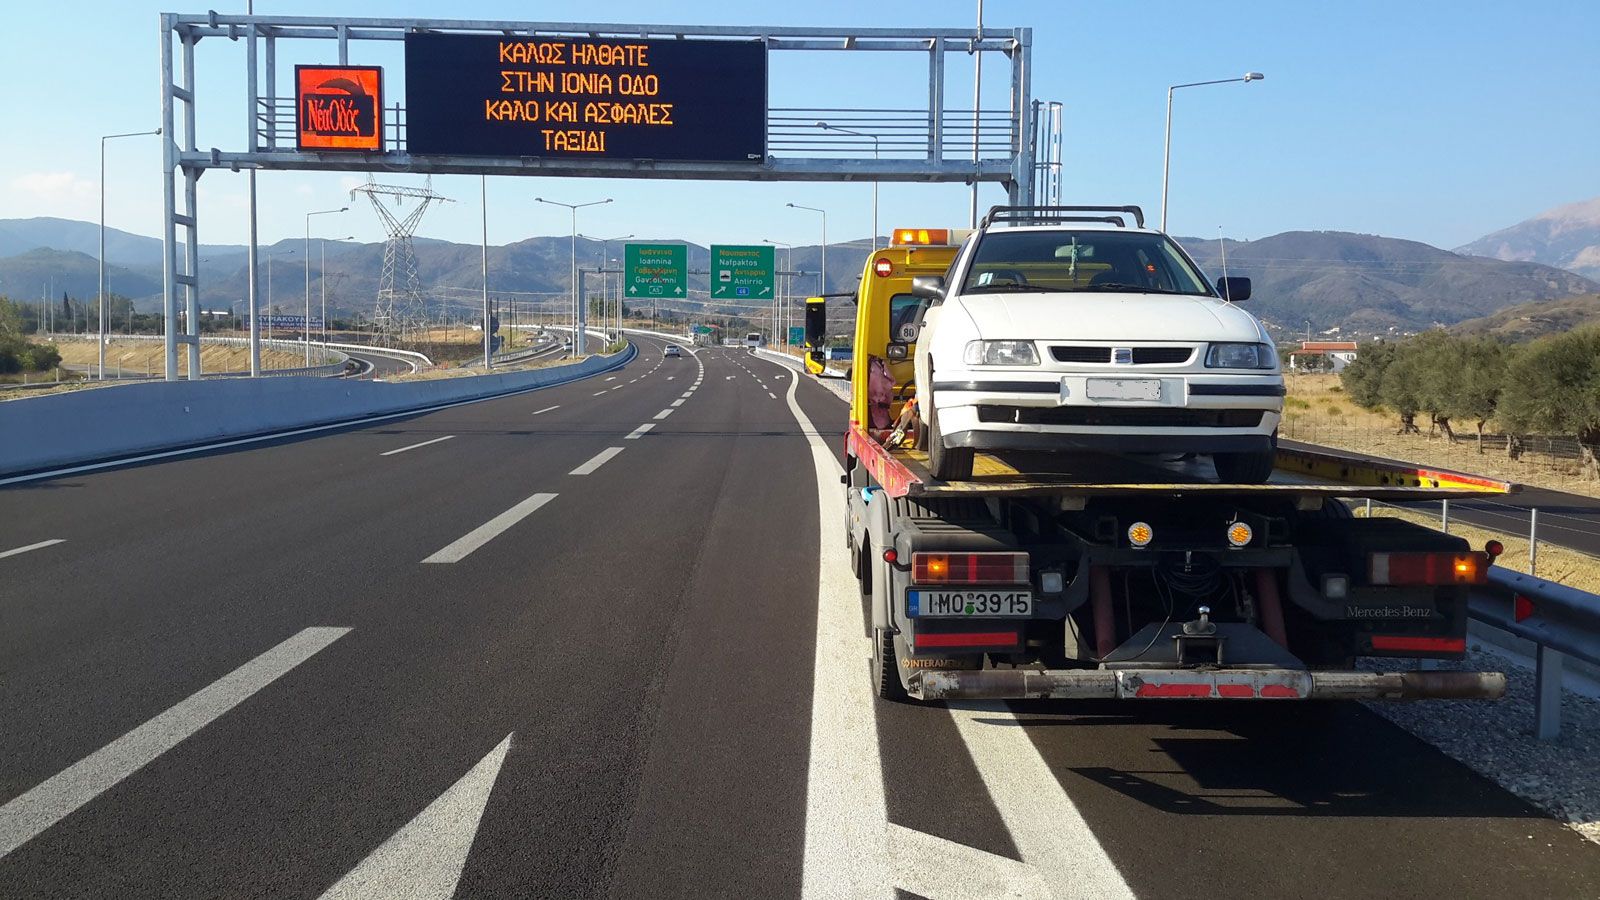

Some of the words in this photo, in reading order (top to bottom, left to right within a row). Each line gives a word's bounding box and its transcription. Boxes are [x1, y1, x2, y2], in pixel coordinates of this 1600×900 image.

[499, 41, 565, 64] ΚΑΛΩΣ
[572, 43, 649, 67] ΗΛΘΑΤΕ
[500, 71, 554, 93] ΣΤΗΝ
[561, 72, 612, 95] ΙΟΝΙΑ
[618, 74, 658, 96] ΟΔΟ
[485, 99, 539, 121] ΚΑΛΟ
[545, 101, 578, 122] ΚΑΙ
[584, 102, 674, 125] ΑΣΦΑΛΕΣ
[541, 129, 606, 152] ΤΑΞΙΔΙ
[719, 259, 758, 267] Nafpaktos
[903, 328, 915, 337] 80
[1347, 605, 1432, 618] Mercedes-Benz
